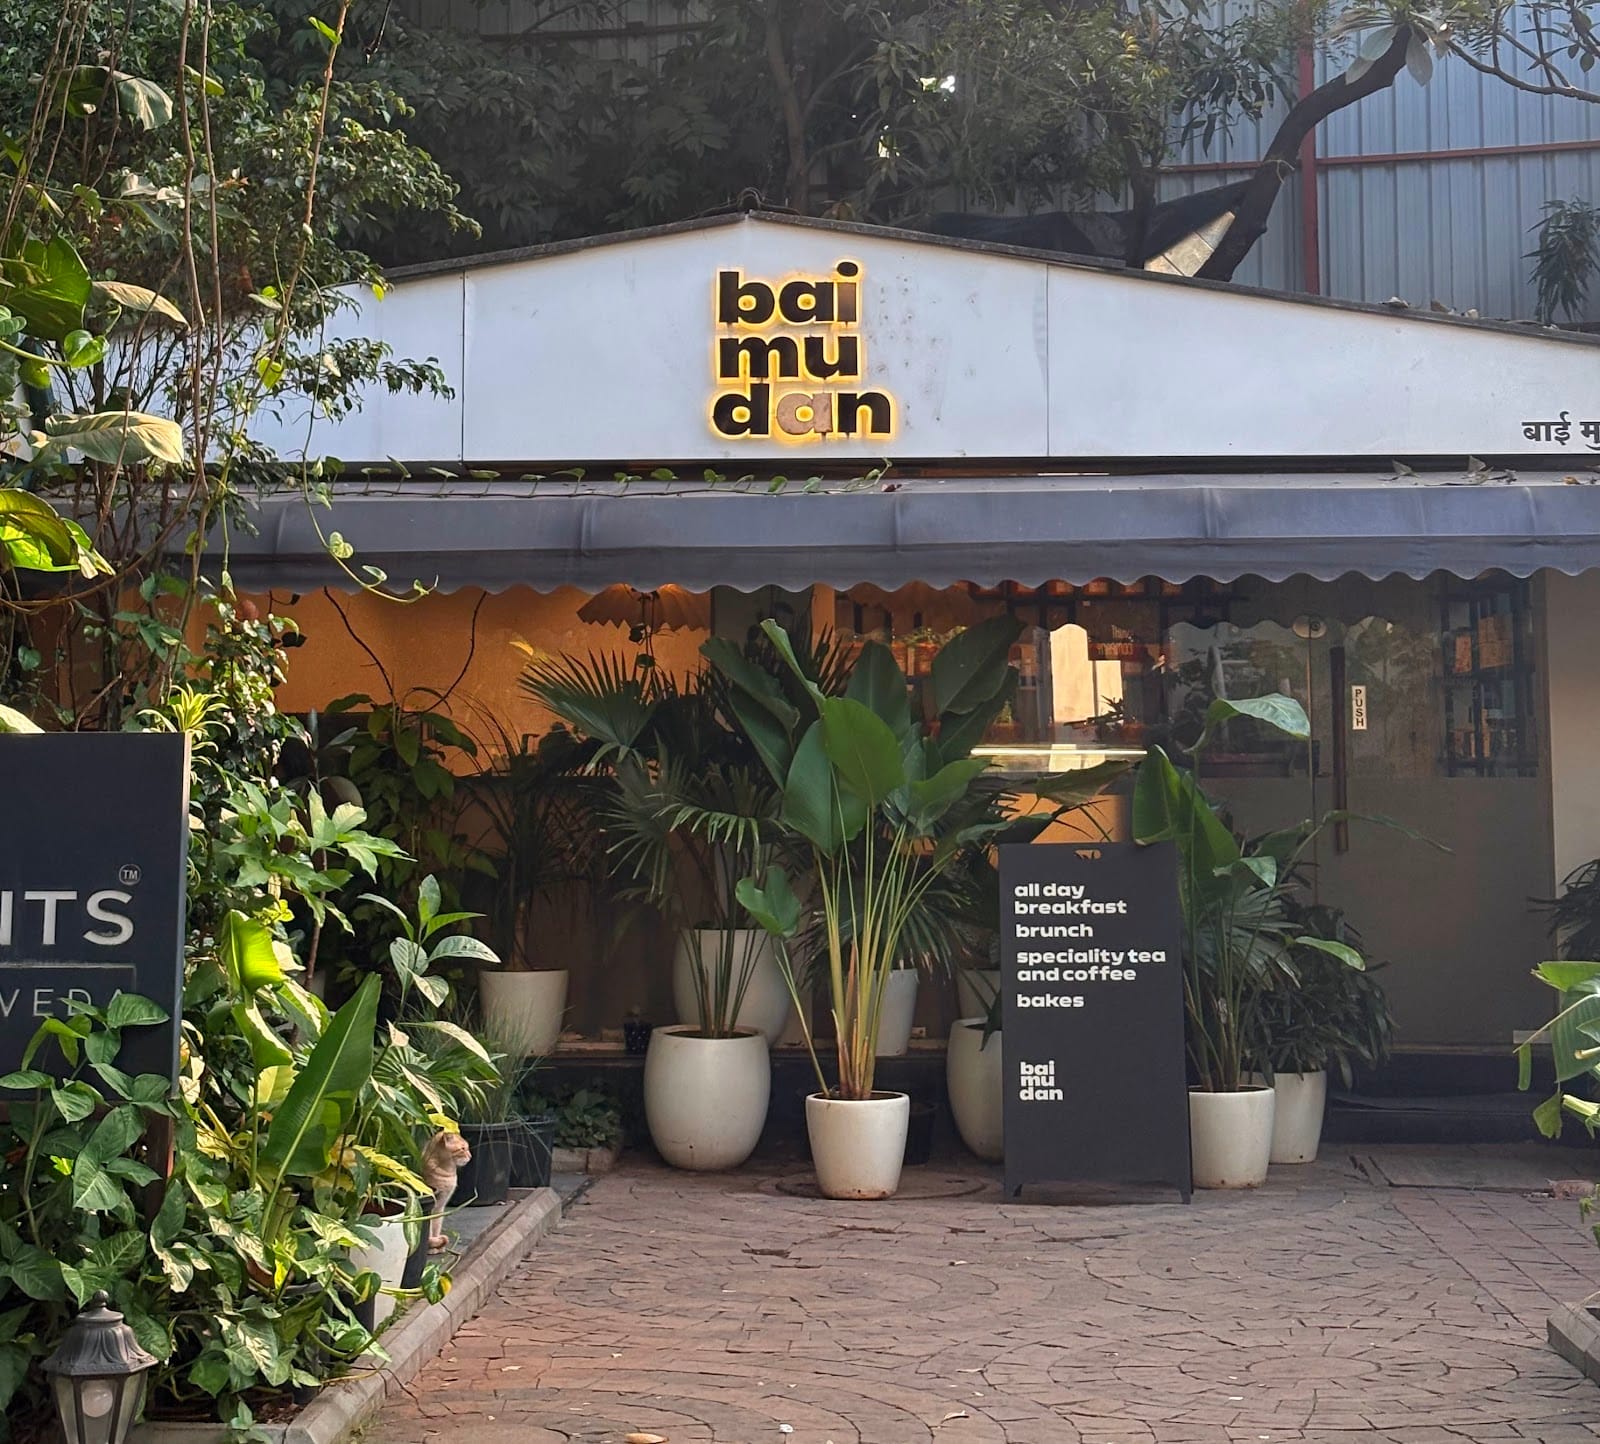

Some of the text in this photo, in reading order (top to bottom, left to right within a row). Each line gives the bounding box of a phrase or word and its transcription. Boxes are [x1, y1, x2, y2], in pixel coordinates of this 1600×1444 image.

[719, 261, 859, 324] bai
[719, 336, 858, 379] mu
[713, 383, 891, 436] dan
[1521, 411, 1571, 446] बाई
[1355, 688, 1364, 727] PUSH
[1014, 883, 1085, 899] all day
[1014, 899, 1127, 914] breakfast
[1015, 924, 1093, 937] brunch
[1017, 949, 1166, 966] speciality tea
[1017, 966, 1137, 981] and coffee
[1017, 994, 1085, 1008] bakes
[1020, 1060, 1055, 1075] bai
[1020, 1075, 1055, 1087] mu
[1019, 1086, 1064, 1101] dan
